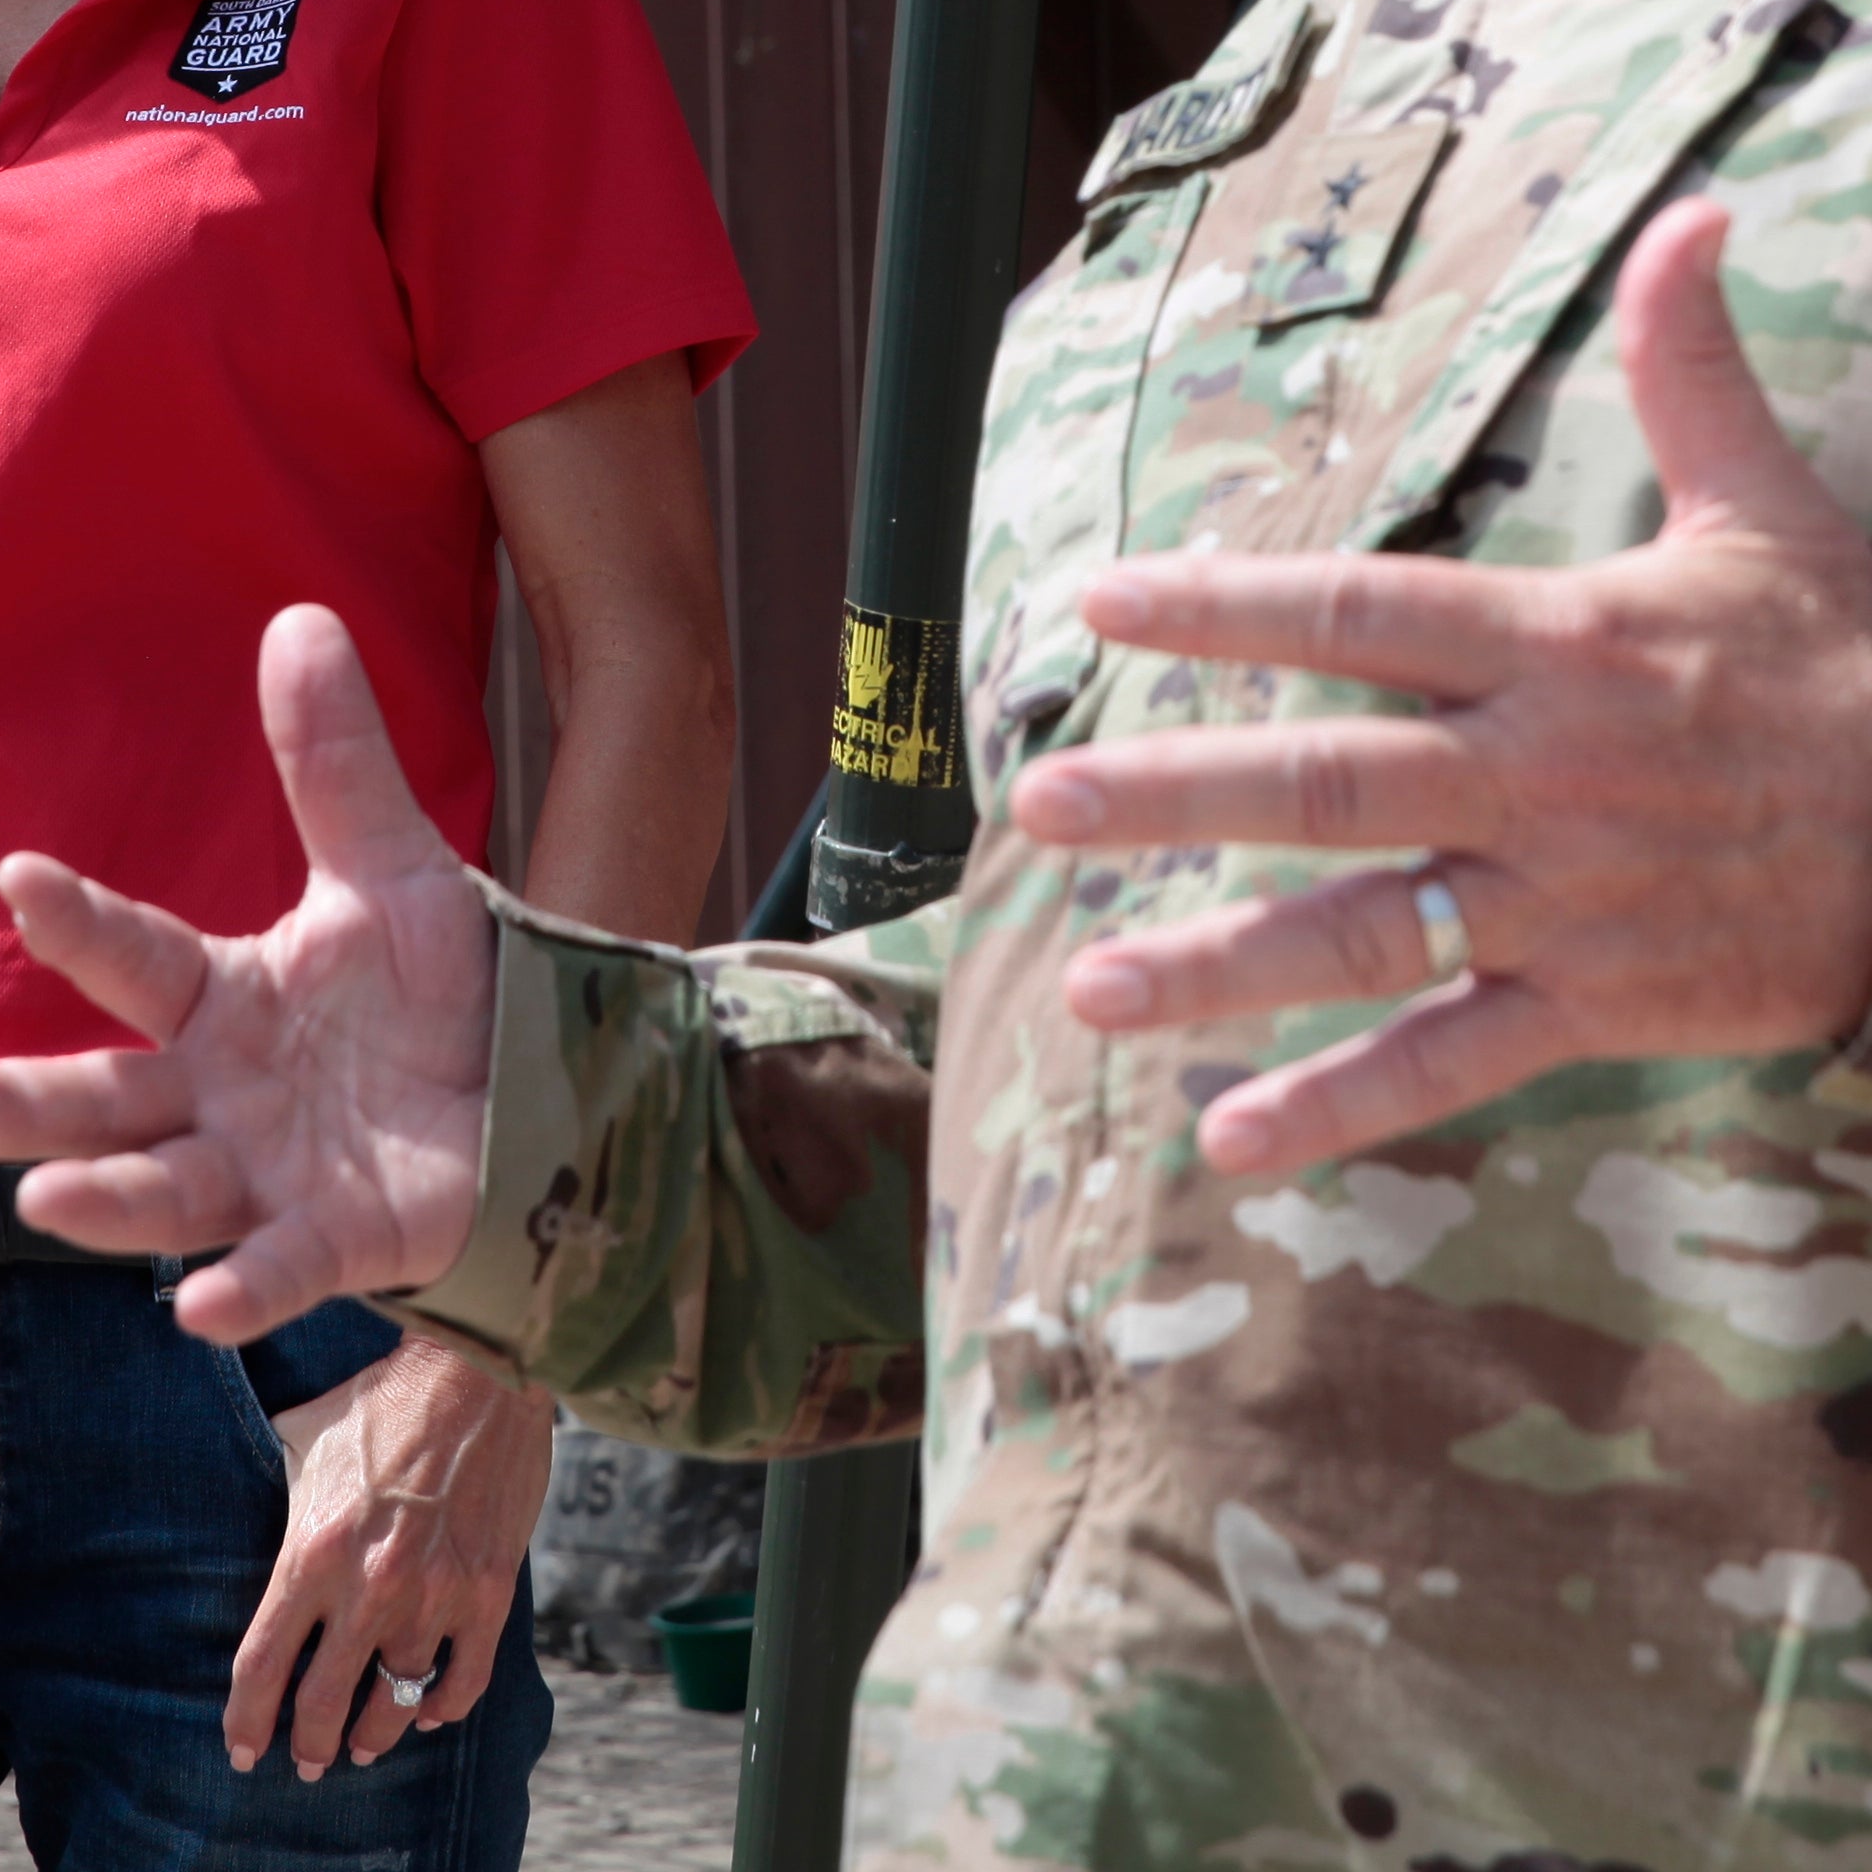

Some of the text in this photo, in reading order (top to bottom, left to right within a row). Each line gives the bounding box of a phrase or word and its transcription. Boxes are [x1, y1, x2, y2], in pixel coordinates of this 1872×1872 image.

[200, 2, 295, 34] ARMY
[210, 0, 255, 12] SOUTH
[192, 26, 287, 47] NATIONAL
[186, 41, 282, 67] GUARD
[125, 104, 305, 127] nationalguard.com
[556, 1456, 617, 1516] US
